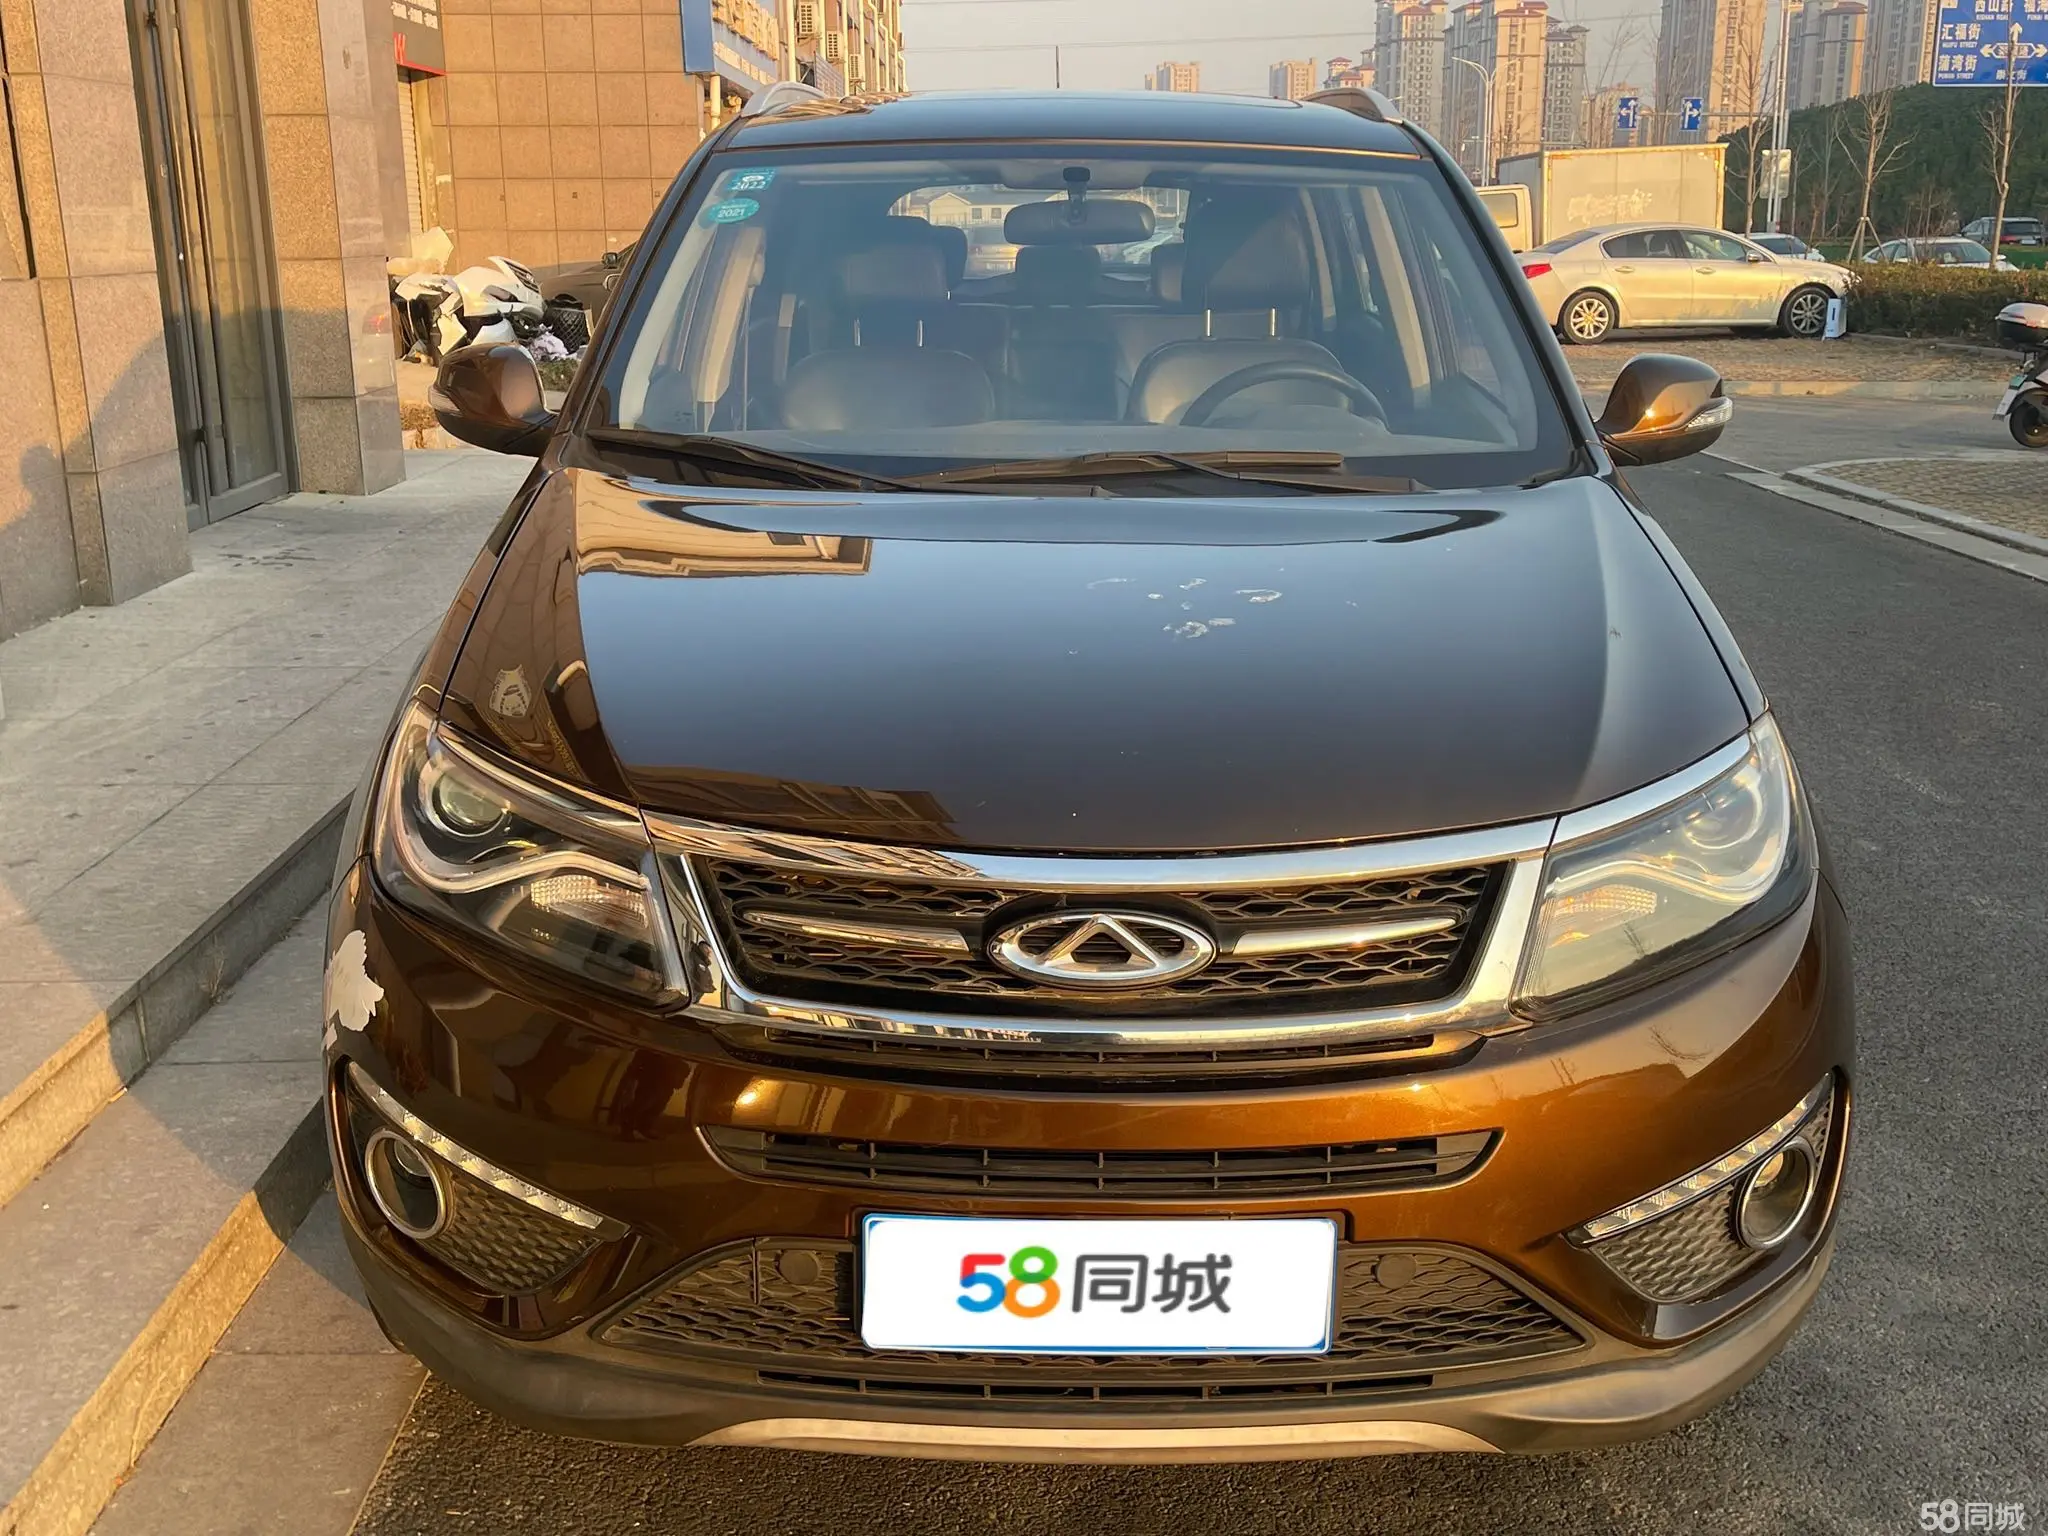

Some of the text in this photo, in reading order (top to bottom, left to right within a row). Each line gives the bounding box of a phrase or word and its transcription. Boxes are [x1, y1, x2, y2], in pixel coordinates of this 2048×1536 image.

[1941, 23, 1981, 40] 汇福街
[1938, 54, 1978, 72] 蒲湾街
[717, 208, 746, 218] 2021
